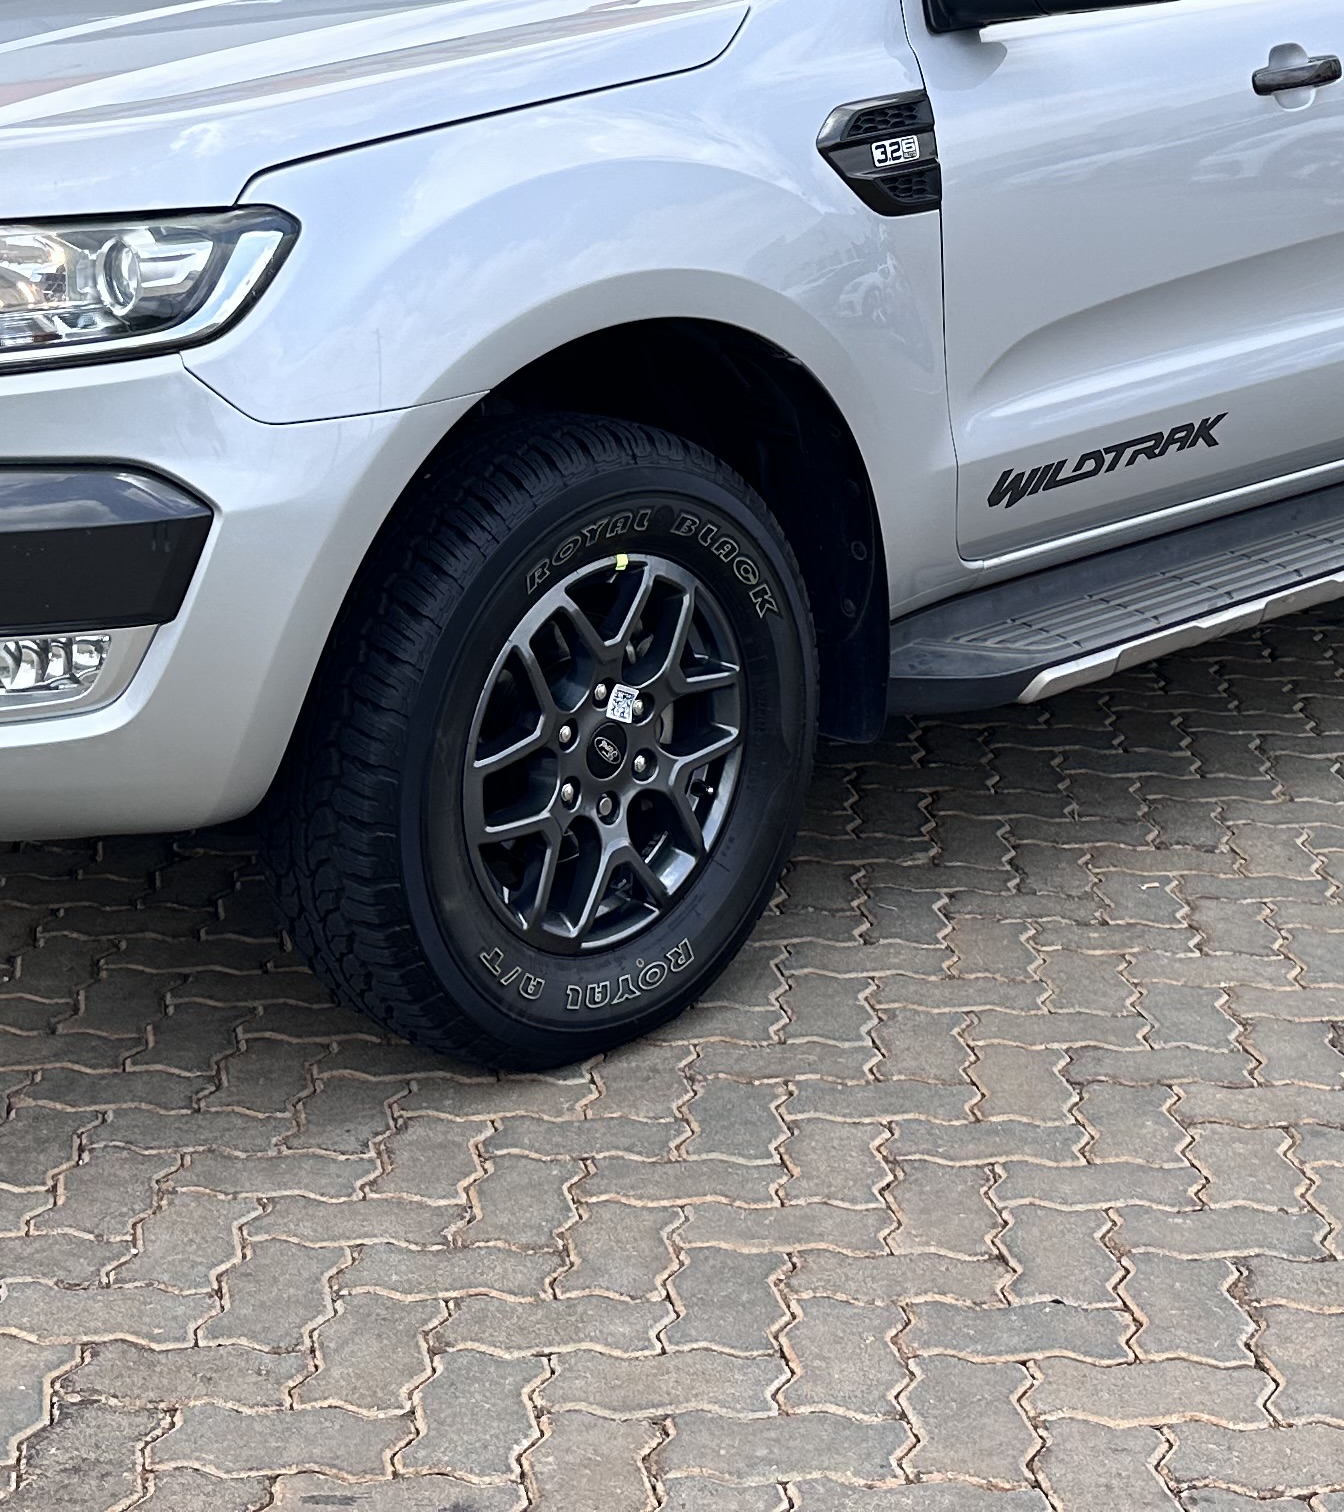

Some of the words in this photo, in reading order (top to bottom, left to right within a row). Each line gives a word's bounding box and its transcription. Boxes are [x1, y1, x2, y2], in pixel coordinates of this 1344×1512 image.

[987, 411, 1229, 509] WILDTRAK
[525, 508, 653, 595] ROYAL
[669, 512, 783, 619] BLACK
